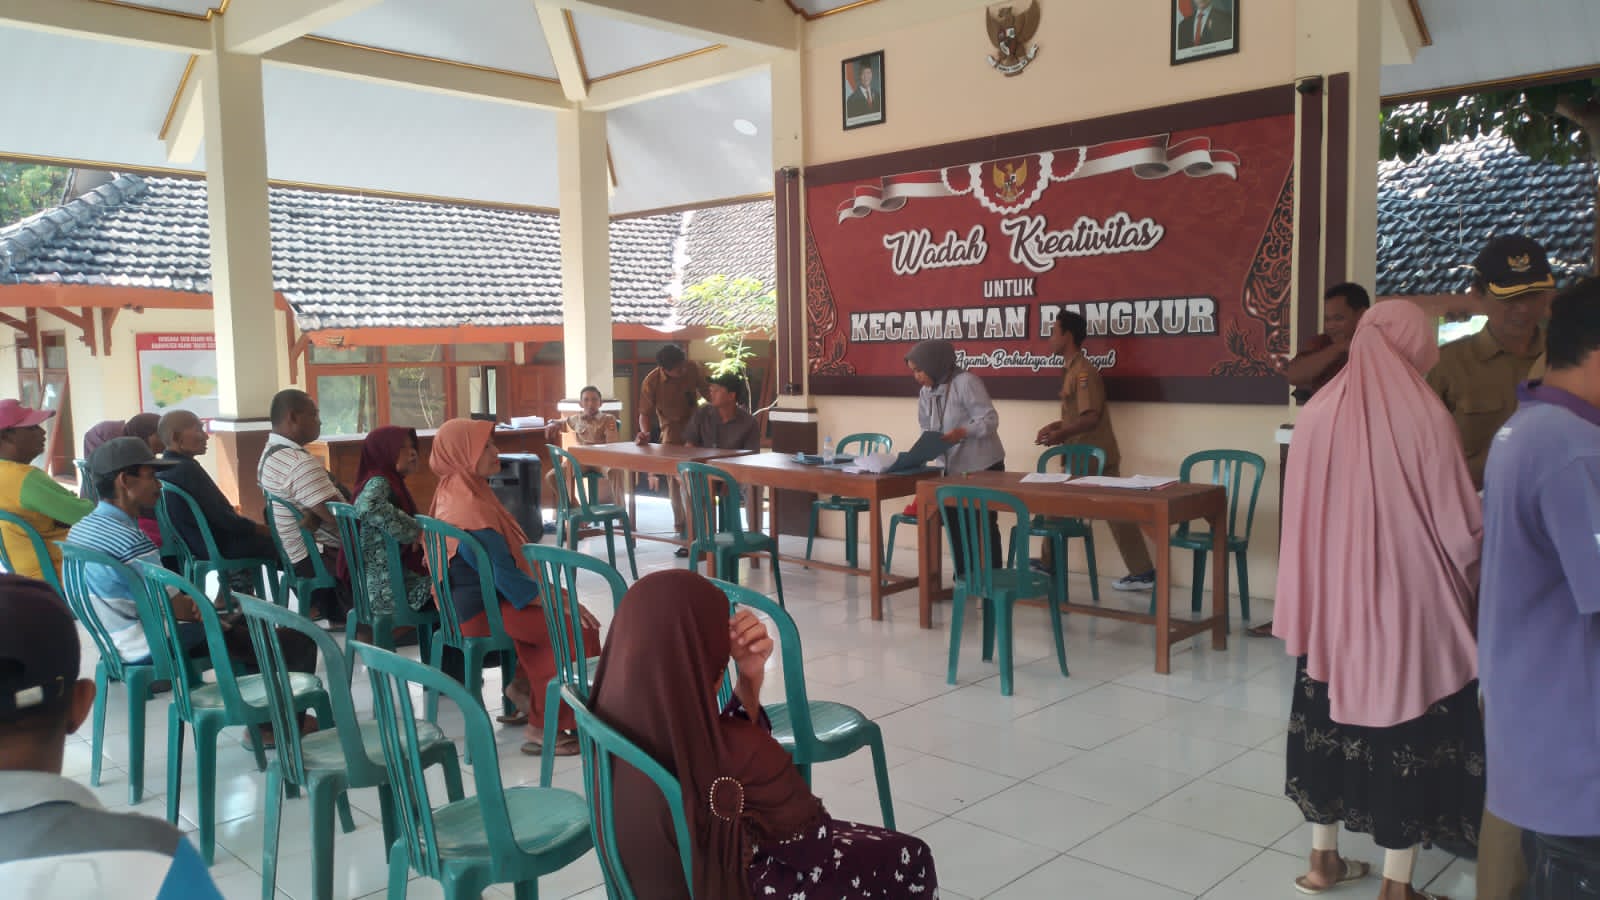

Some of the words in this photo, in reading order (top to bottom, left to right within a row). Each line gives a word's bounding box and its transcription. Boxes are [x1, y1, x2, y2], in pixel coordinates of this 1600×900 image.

[884, 225, 988, 275] Wadah
[1001, 211, 1165, 272] Kreativitas
[983, 278, 1035, 298] UNTUK
[851, 306, 1027, 342] KECAMATAN
[992, 348, 1048, 371] Berbudaya
